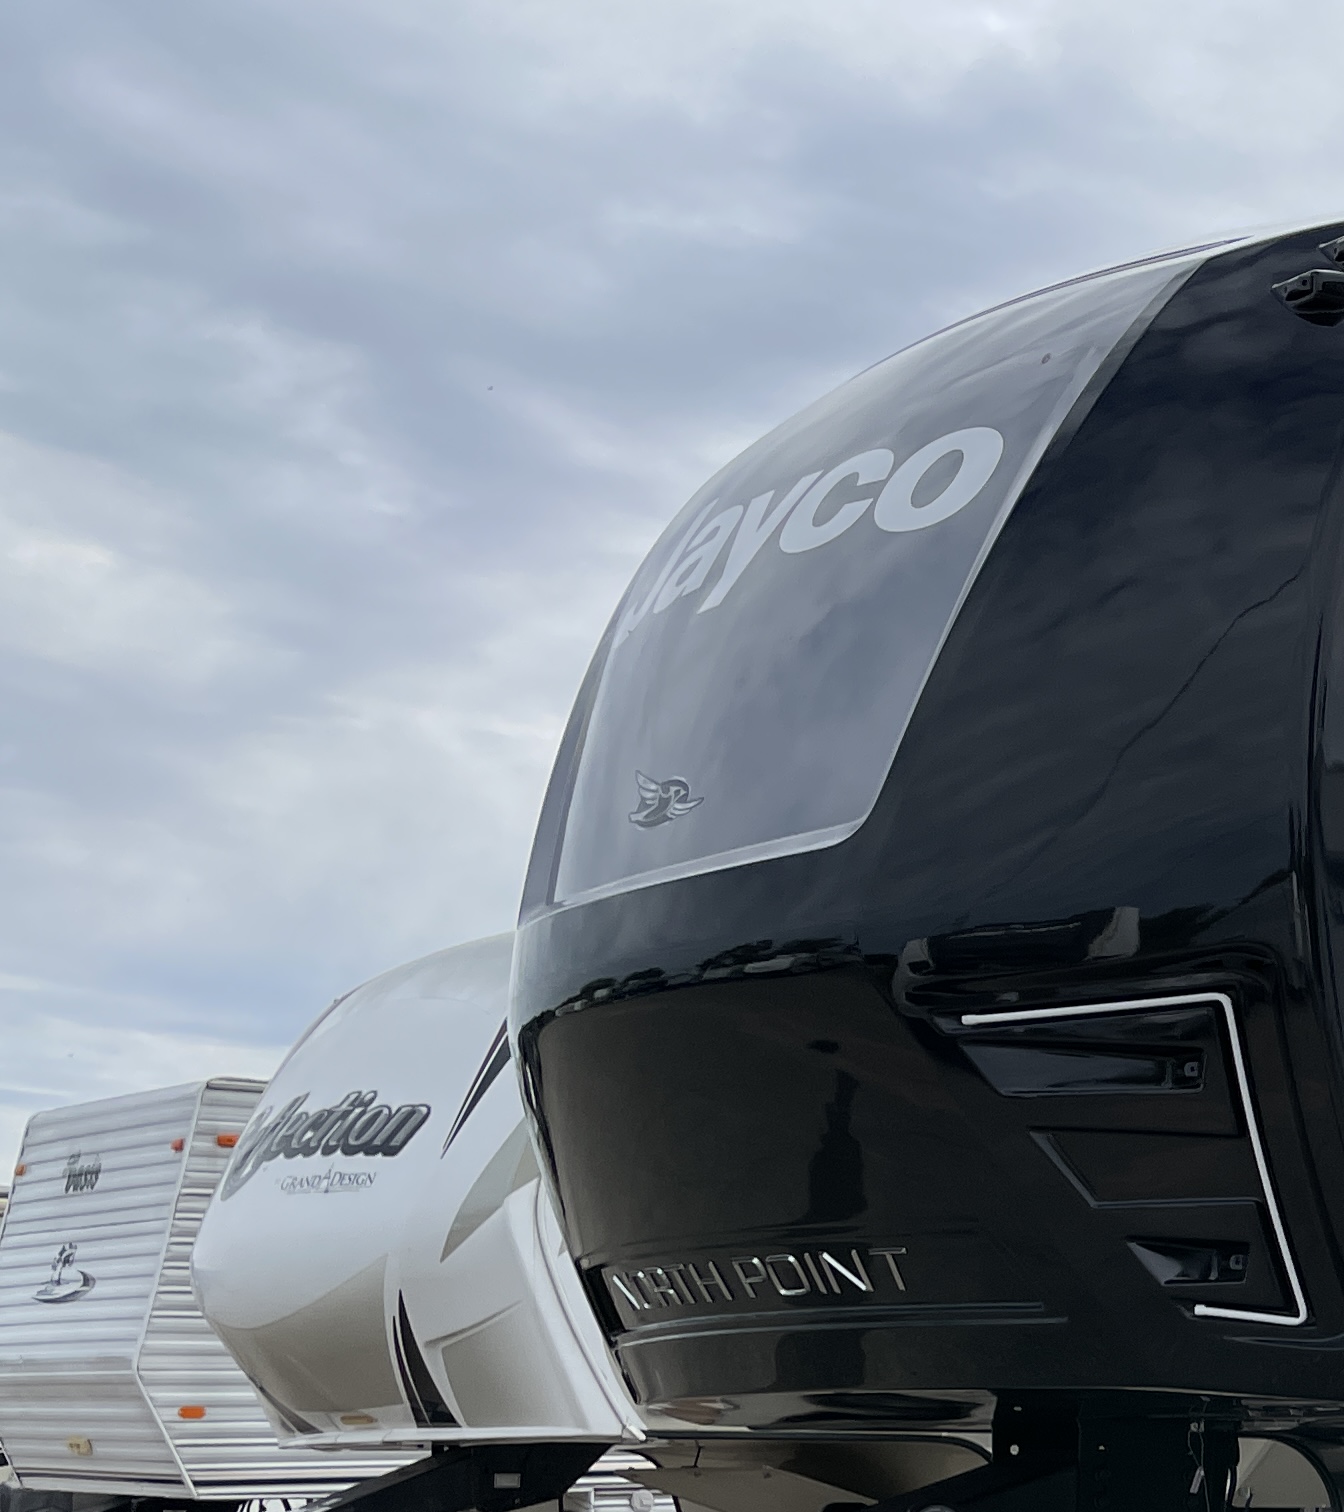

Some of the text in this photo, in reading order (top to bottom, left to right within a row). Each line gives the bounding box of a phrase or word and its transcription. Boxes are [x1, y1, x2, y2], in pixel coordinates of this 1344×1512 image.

[612, 427, 1004, 650] Jayco
[610, 1247, 907, 1310] NORTH POINT
